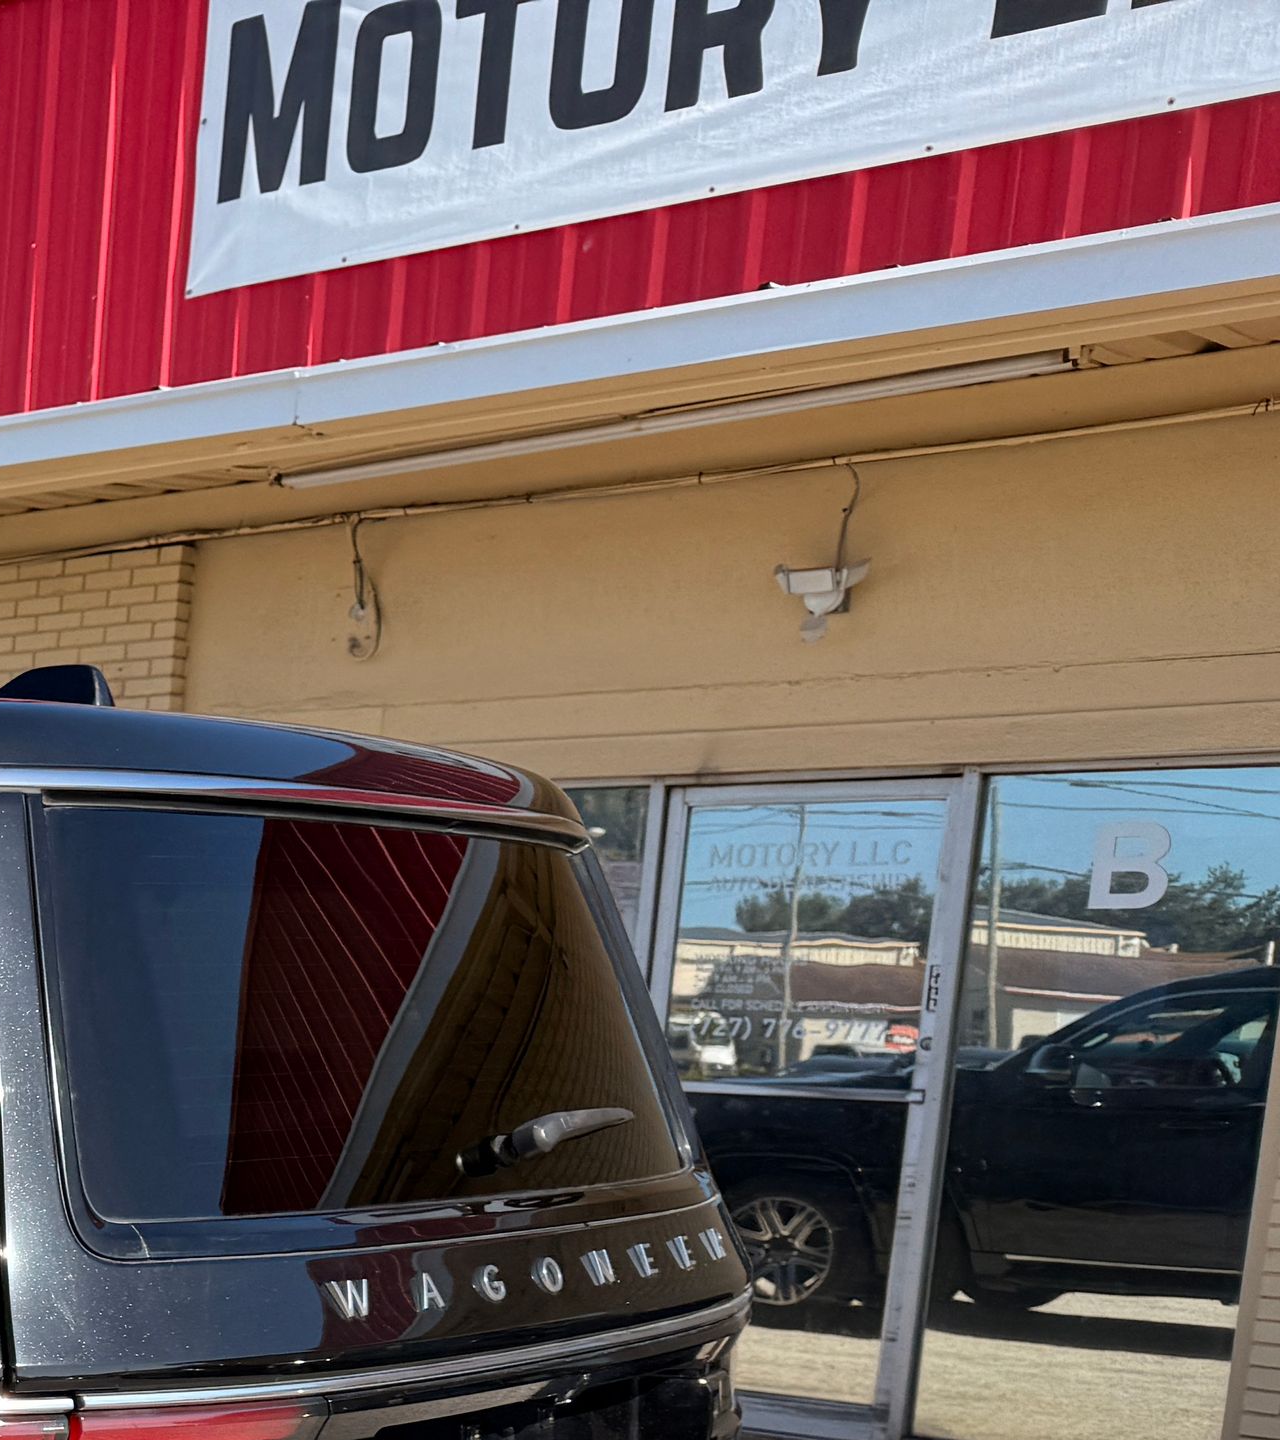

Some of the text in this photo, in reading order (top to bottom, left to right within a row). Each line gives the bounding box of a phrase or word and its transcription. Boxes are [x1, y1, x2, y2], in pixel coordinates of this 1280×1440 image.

[708, 839, 913, 869] MOTORY LLC
[1088, 821, 1171, 909] B
[322, 1227, 728, 1320] WAGONEER
